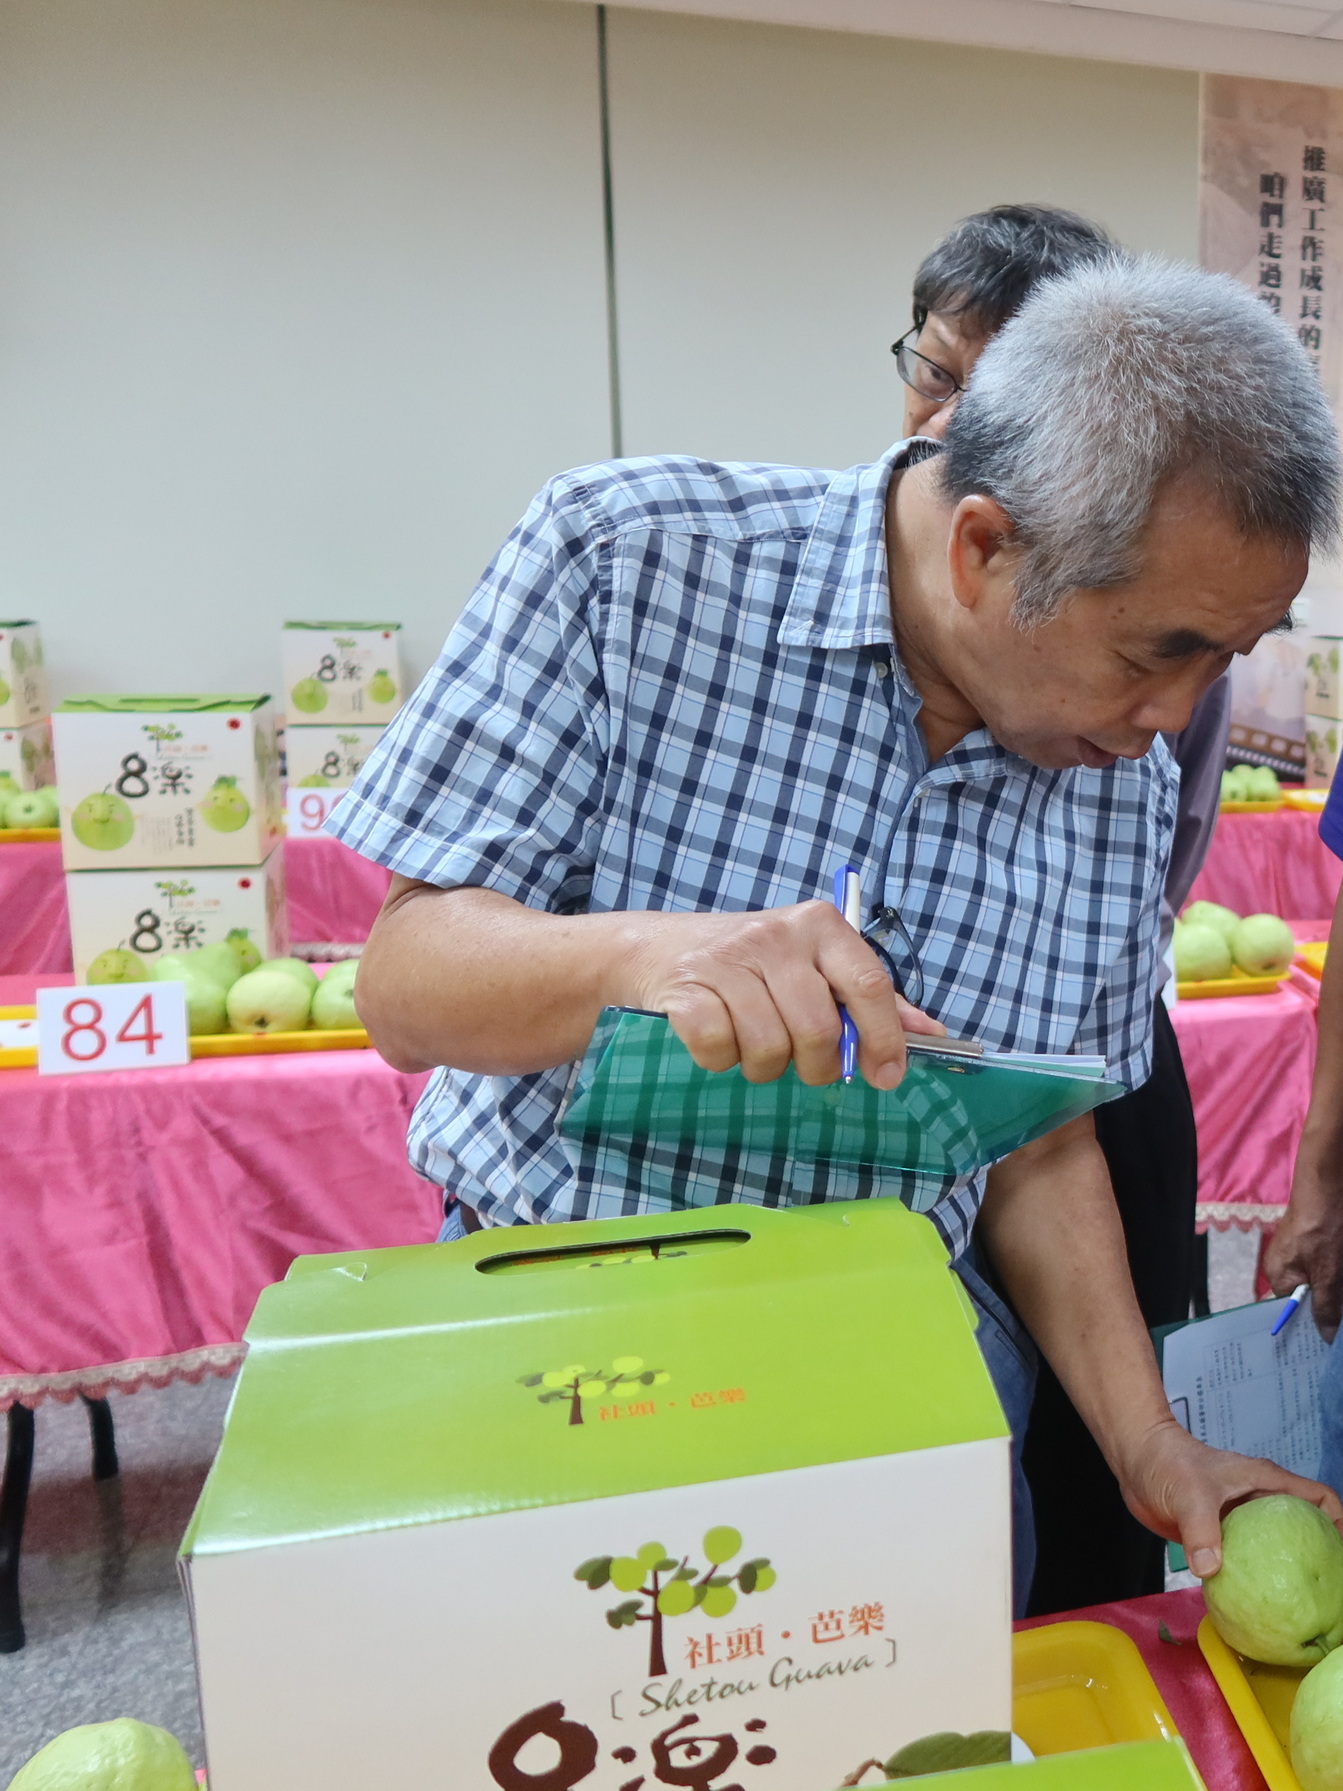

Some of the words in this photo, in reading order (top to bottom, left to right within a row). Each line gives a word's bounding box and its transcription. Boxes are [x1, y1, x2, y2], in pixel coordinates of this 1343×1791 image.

[1298, 145, 1326, 371] 推廣工作成長的
[300, 793, 344, 831] 9
[60, 992, 163, 1062] 84
[638, 1676, 759, 1717] Shetou
[768, 1655, 874, 1687] Guava
